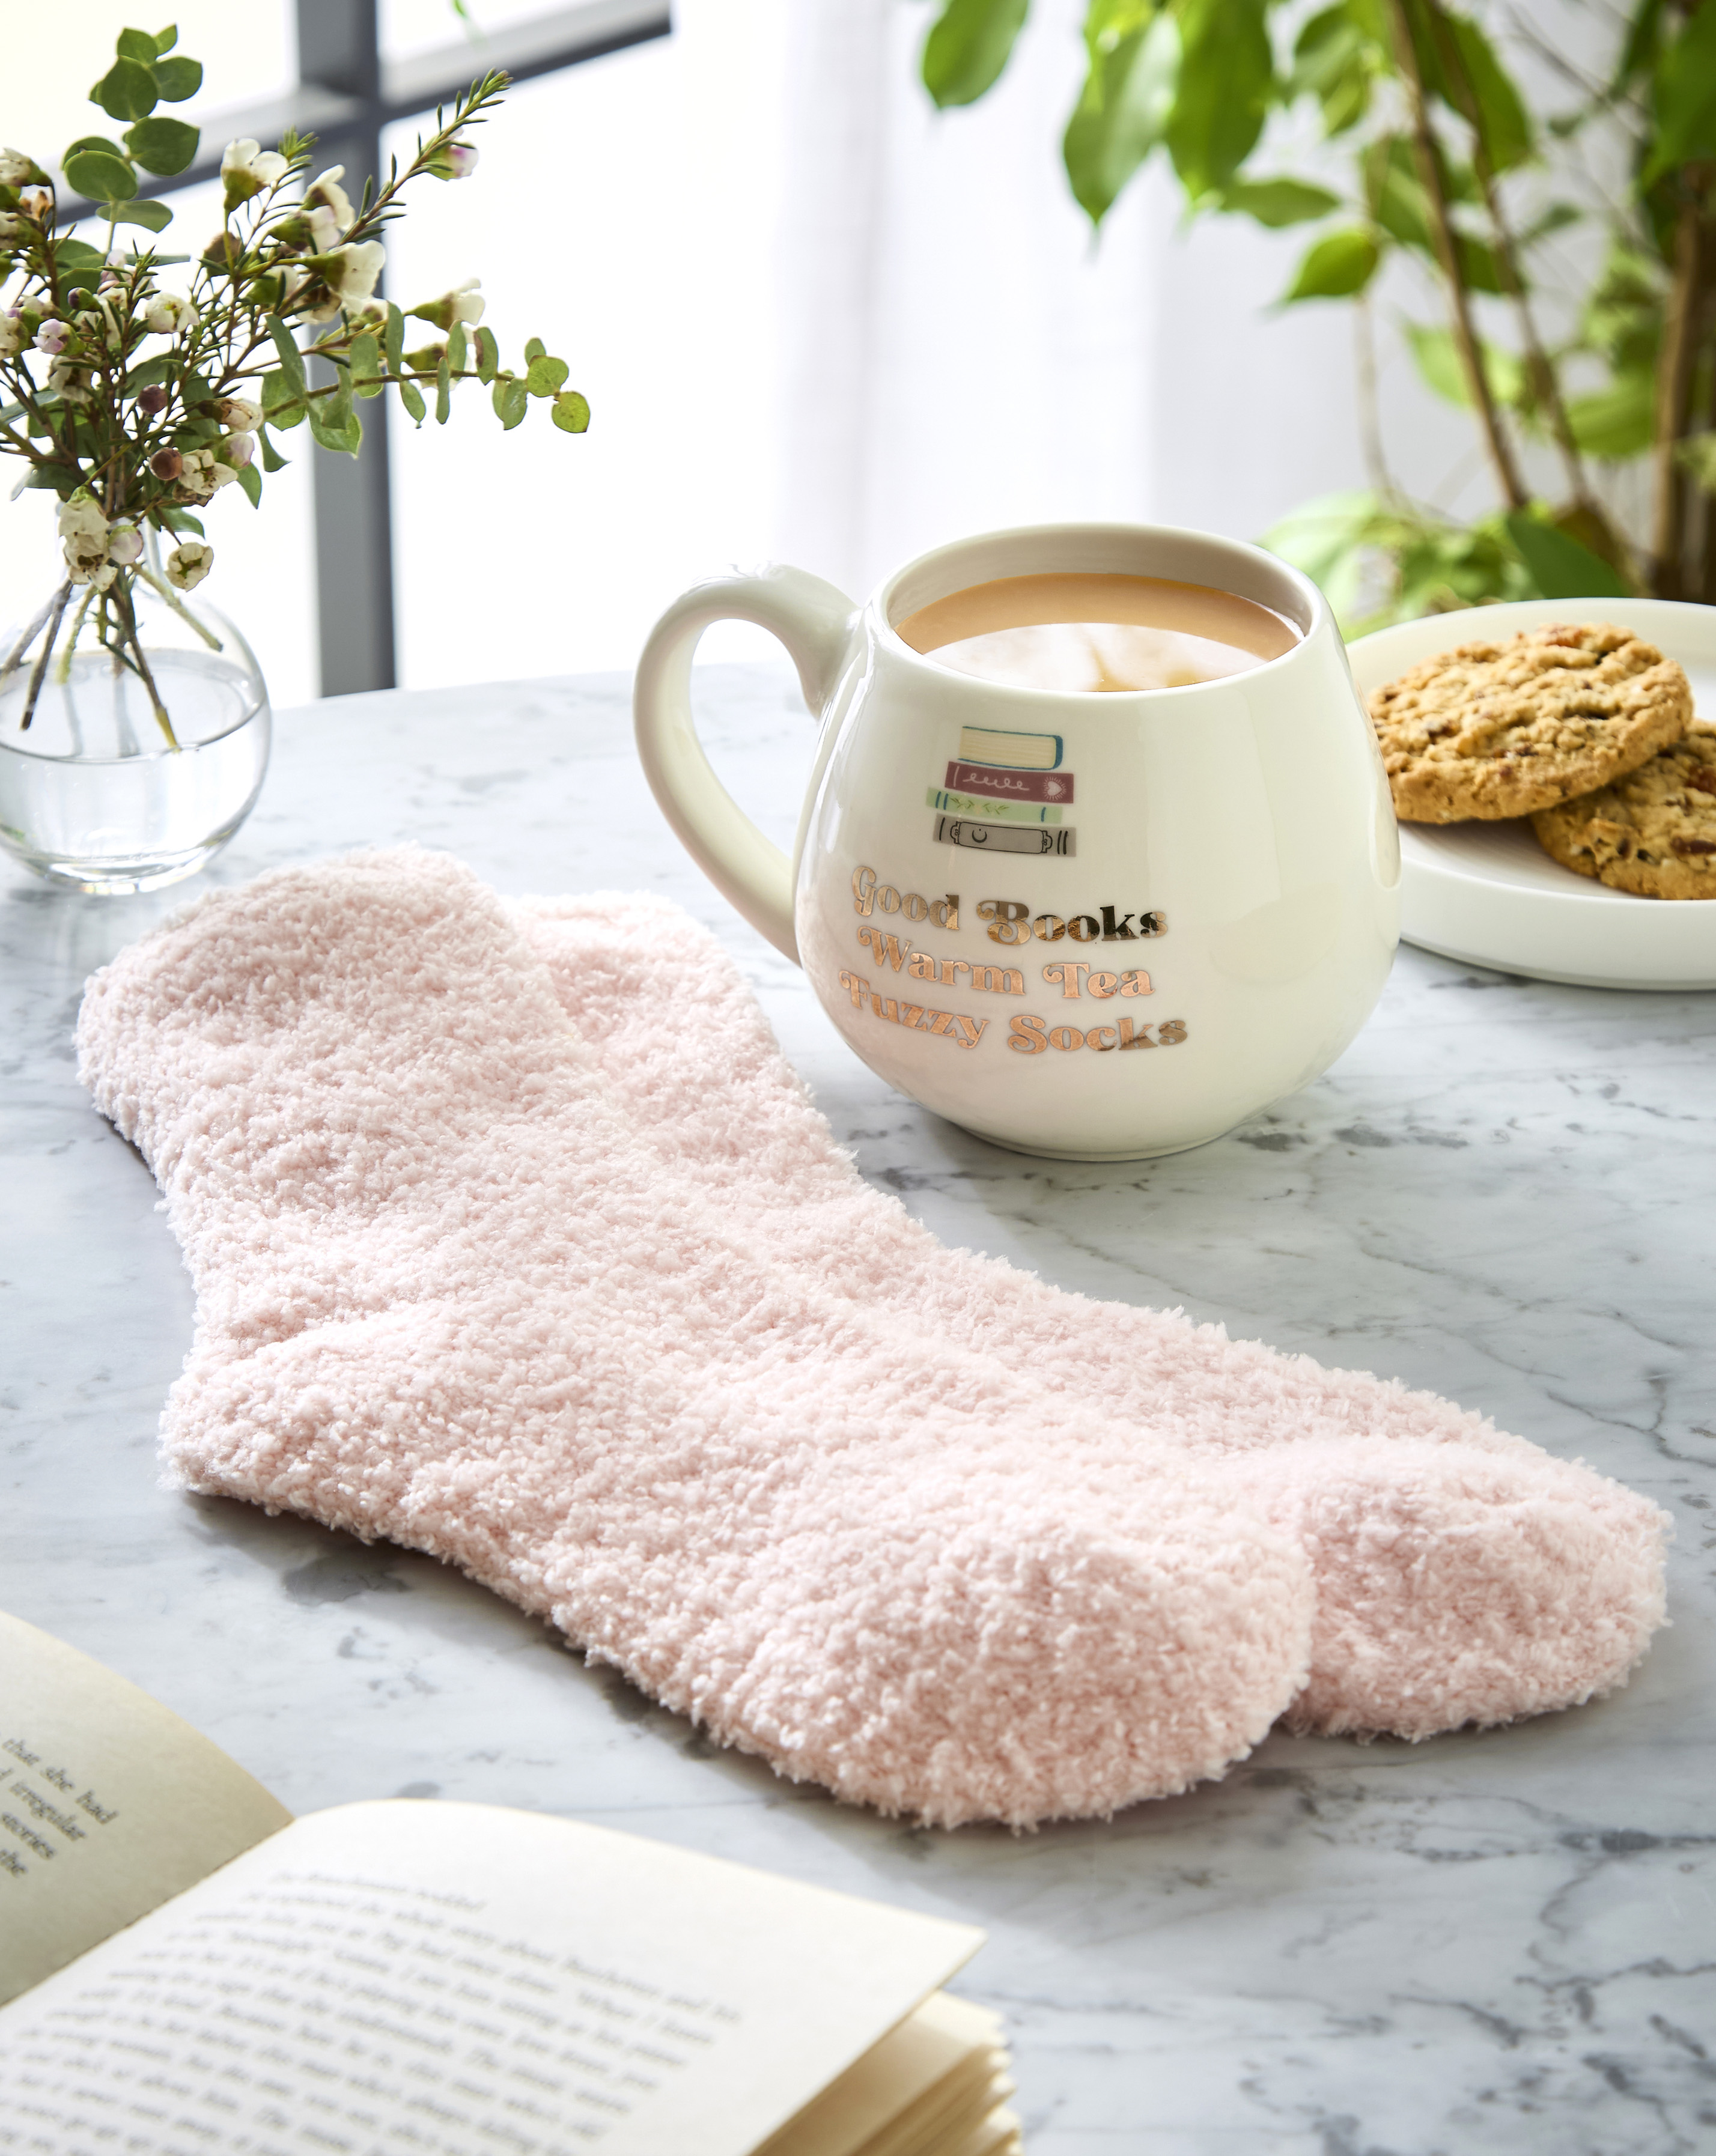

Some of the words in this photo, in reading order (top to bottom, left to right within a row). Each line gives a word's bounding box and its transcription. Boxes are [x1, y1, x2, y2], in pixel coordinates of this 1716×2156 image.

[851, 865, 960, 931] Good
[976, 899, 1168, 946] Books
[857, 925, 1026, 995] Warm
[1042, 962, 1155, 998] Tea
[839, 970, 991, 1050] Fuzzy
[1008, 1015, 1188, 1054] Socks
[9, 1782, 87, 1841] irregular
[40, 1767, 75, 1793] she
[75, 1789, 119, 1824] had
